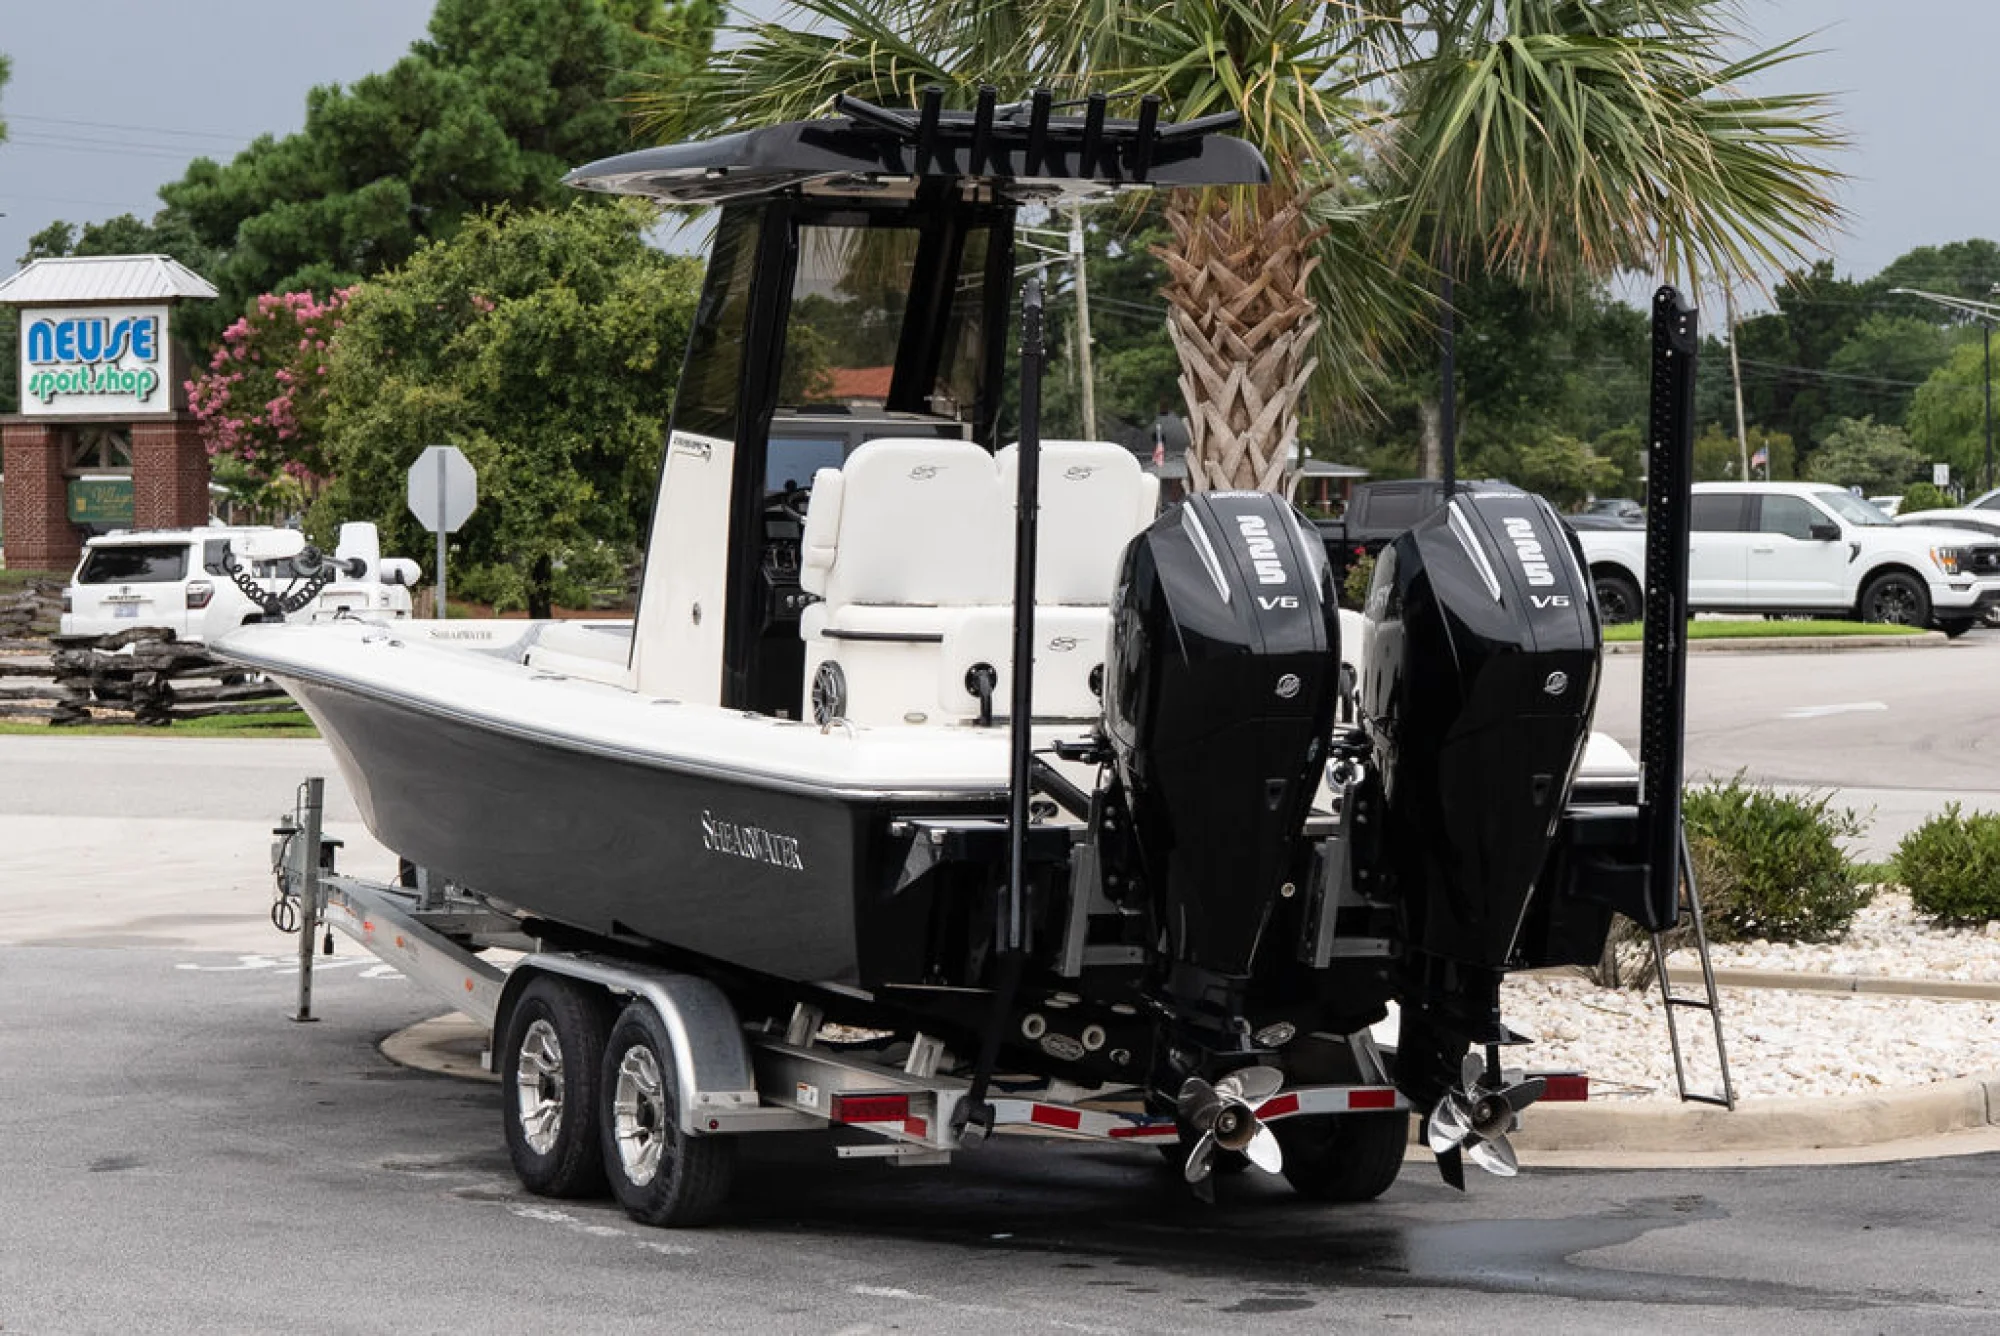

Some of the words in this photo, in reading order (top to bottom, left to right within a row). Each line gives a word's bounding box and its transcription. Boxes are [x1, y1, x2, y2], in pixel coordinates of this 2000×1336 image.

[28, 318, 154, 362] NEUSE
[28, 366, 90, 401] sport
[95, 364, 153, 400] shop
[1235, 514, 1288, 585] 225
[1502, 516, 1556, 587] 225
[1257, 595, 1300, 611] V6
[1530, 594, 1571, 609] V6
[701, 809, 805, 872] SHEARWATER
